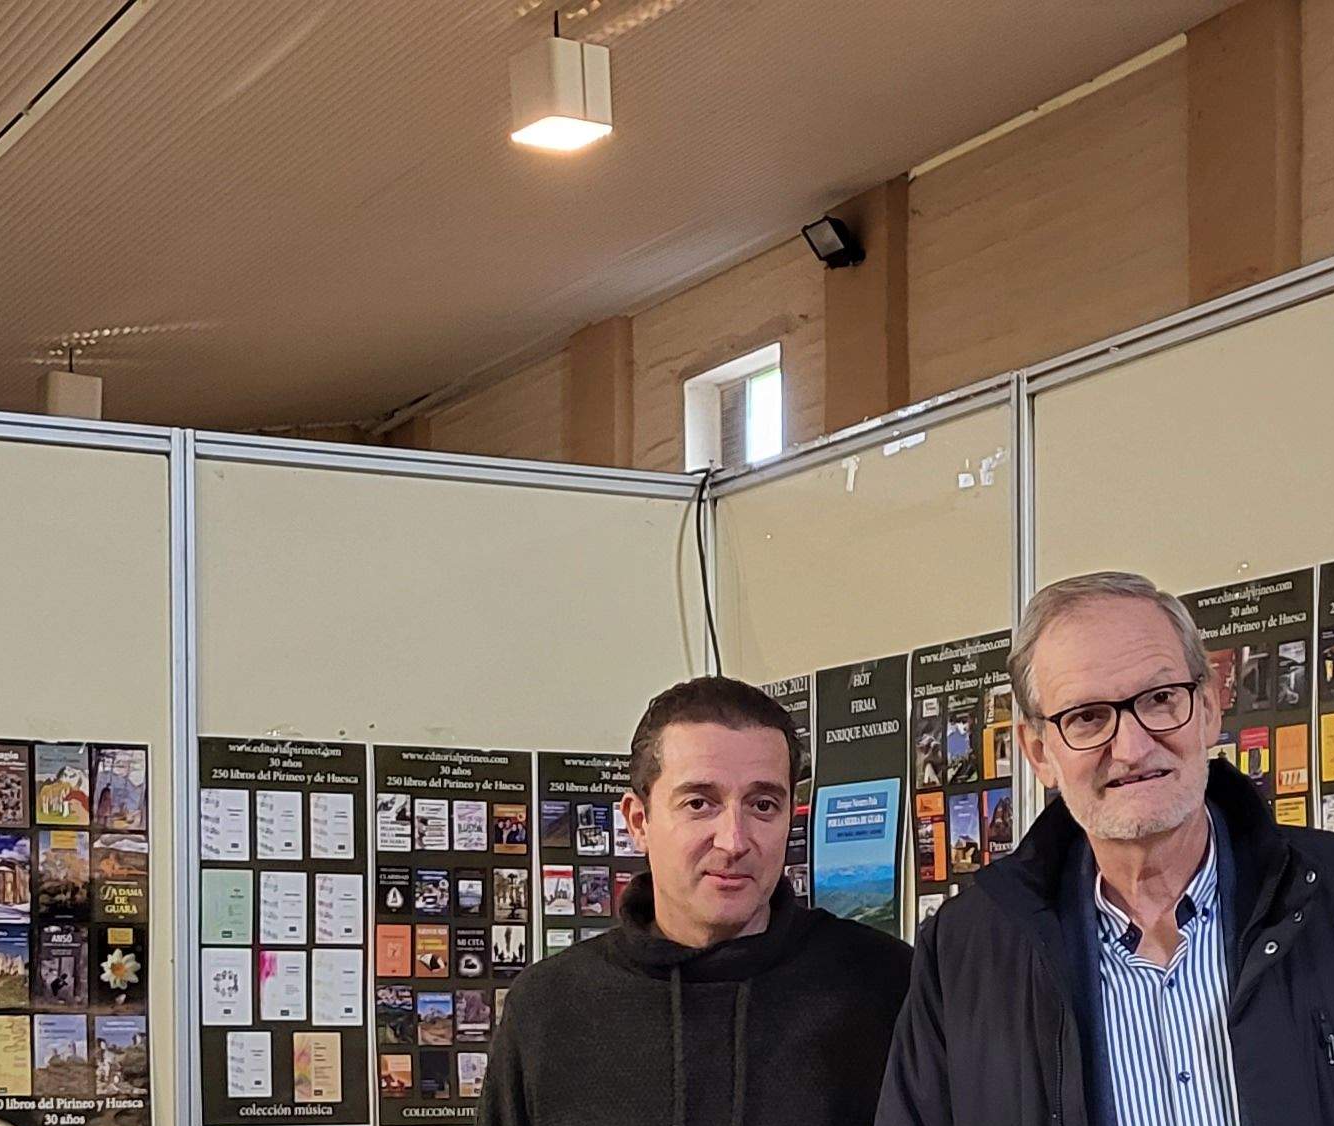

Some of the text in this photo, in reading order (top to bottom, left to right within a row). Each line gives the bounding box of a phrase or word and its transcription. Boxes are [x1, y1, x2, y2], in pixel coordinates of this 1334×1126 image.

[853, 672, 872, 688] HOY
[851, 697, 876, 715] FIRMA
[826, 720, 900, 744] ENRIQUE NAVARRO
[239, 1104, 333, 1116] colección música
[402, 1107, 456, 1118] COLECCIÓN
[44, 1113, 85, 1125] 30 años
